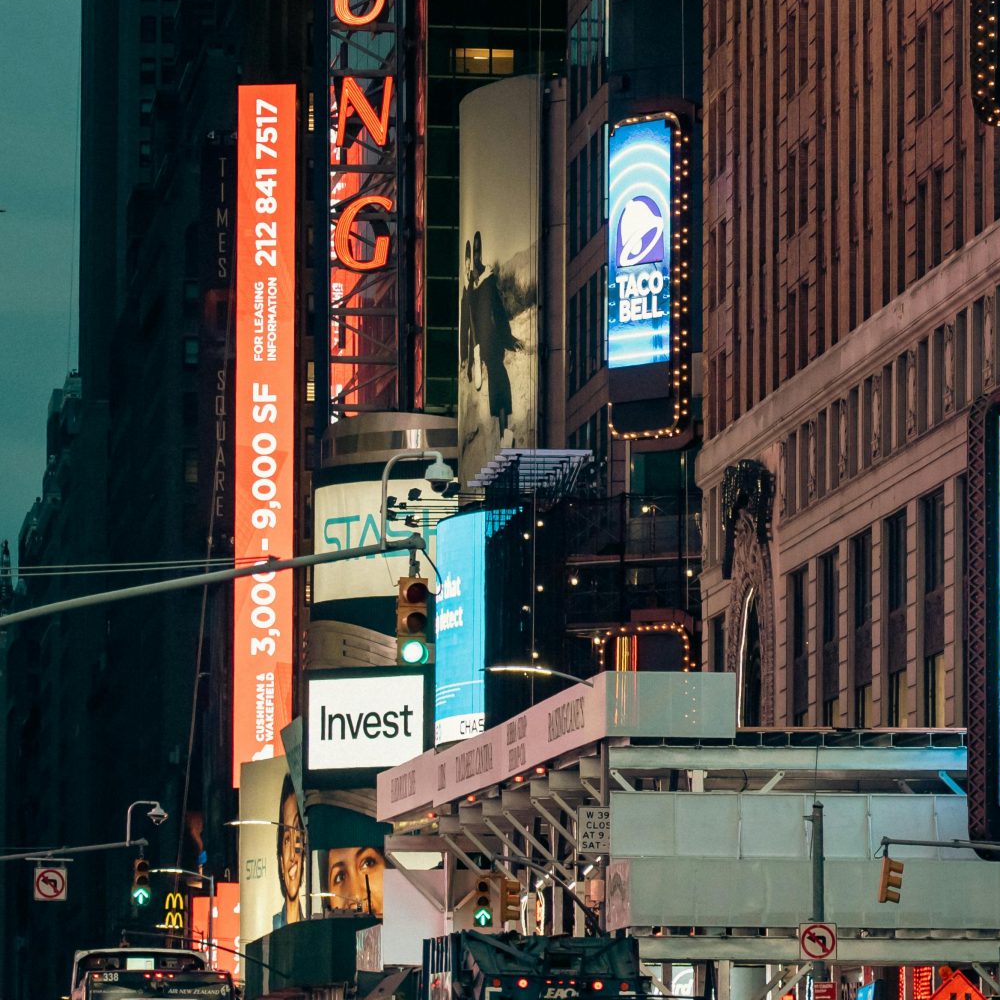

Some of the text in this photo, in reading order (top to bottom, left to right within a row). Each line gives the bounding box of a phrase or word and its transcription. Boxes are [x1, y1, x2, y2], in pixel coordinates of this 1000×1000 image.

[255, 99, 278, 267] 212 841 7517
[616, 269, 663, 299] TACO
[254, 281, 264, 362] FOR LEASING
[267, 277, 278, 362] INFORMATION
[619, 295, 664, 323] BELL
[215, 157, 229, 518] TIMES SQUARE
[252, 382, 278, 424] SF
[251, 432, 282, 529] 9,000
[256, 684, 265, 742] CUSHMAN
[265, 671, 275, 743] WAKEFIELD
[320, 704, 414, 742] Invest
[459, 719, 485, 736] CHAS
[586, 811, 594, 819] W
[586, 822, 610, 830] CLOS
[582, 831, 604, 840] AT 9
[245, 857, 267, 881] STASH
[103, 972, 120, 983] 338
